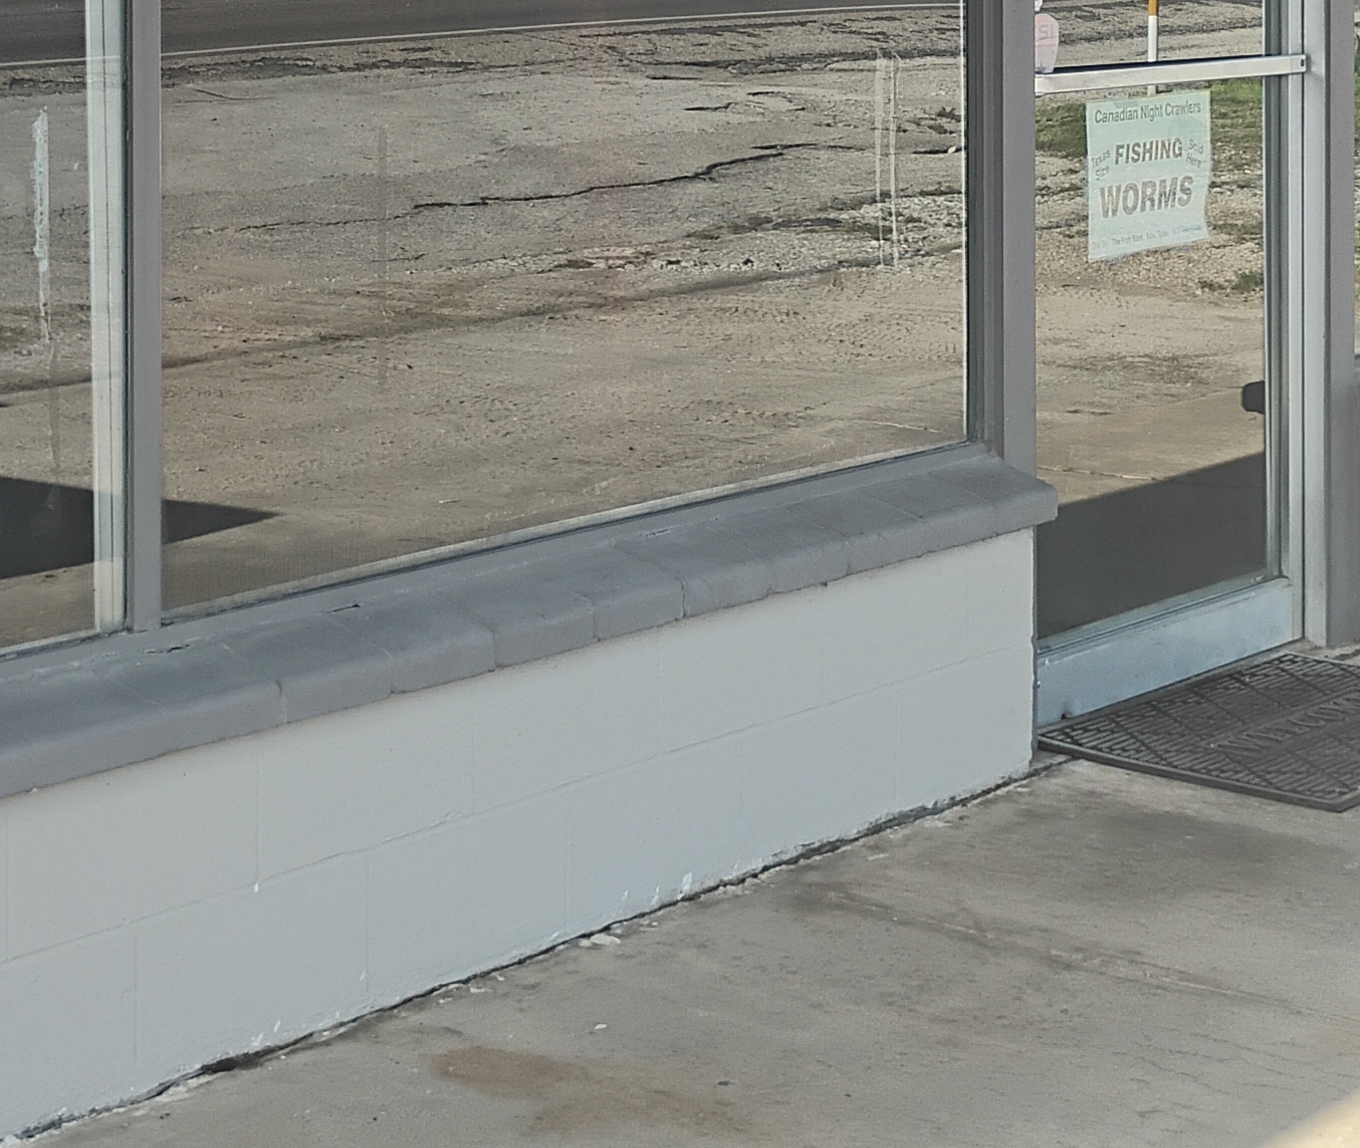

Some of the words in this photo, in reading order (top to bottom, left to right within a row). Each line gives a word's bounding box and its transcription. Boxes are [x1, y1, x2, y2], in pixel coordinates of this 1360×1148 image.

[1094, 107, 1138, 124] Canadian
[1140, 105, 1163, 122] Night
[1165, 101, 1201, 116] Crawlers
[1091, 149, 1111, 167] Texas
[1115, 137, 1183, 165] FISHING
[1186, 153, 1202, 168] Here
[1099, 175, 1194, 219] WORMS
